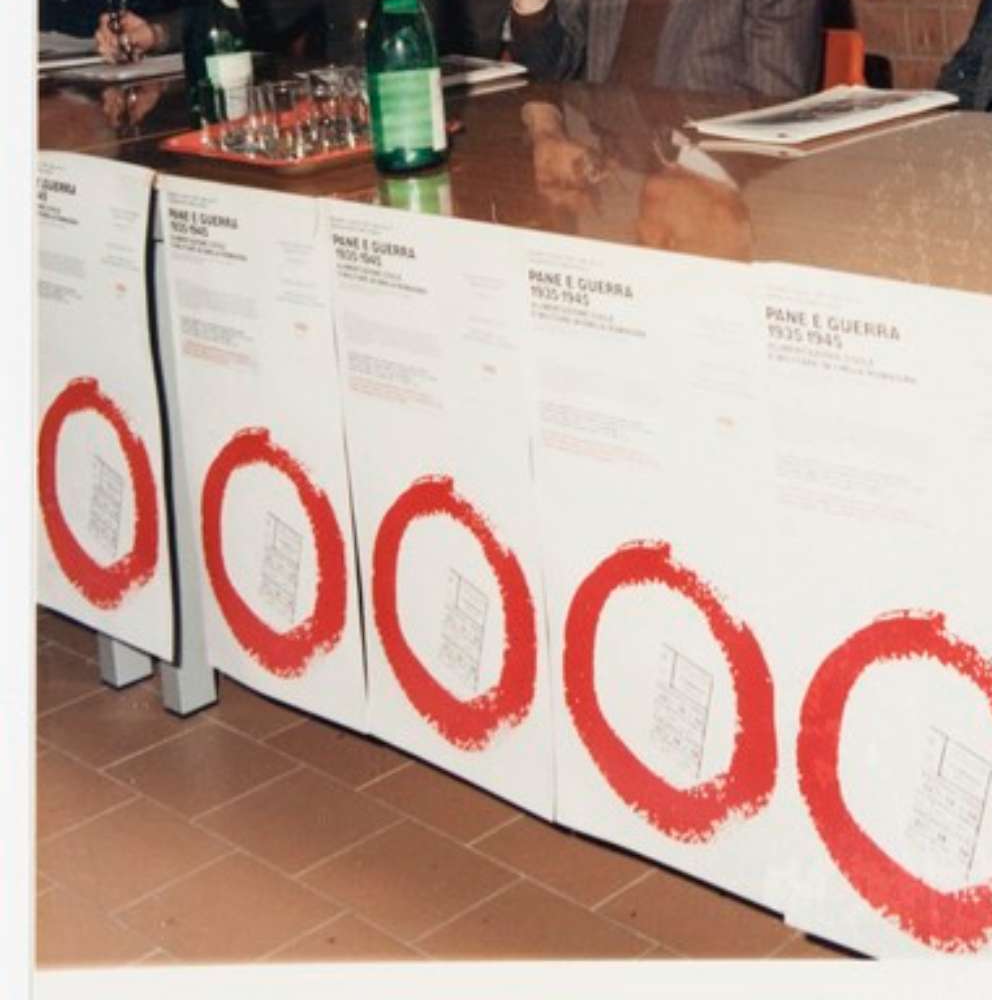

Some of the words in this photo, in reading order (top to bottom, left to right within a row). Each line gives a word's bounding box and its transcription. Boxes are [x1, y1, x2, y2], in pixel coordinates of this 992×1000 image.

[528, 268, 561, 287] PANE
[565, 275, 573, 289] E
[577, 278, 633, 299] GUERRA
[765, 305, 807, 326] PANE
[812, 313, 821, 329] E
[827, 315, 901, 341] GUERRA
